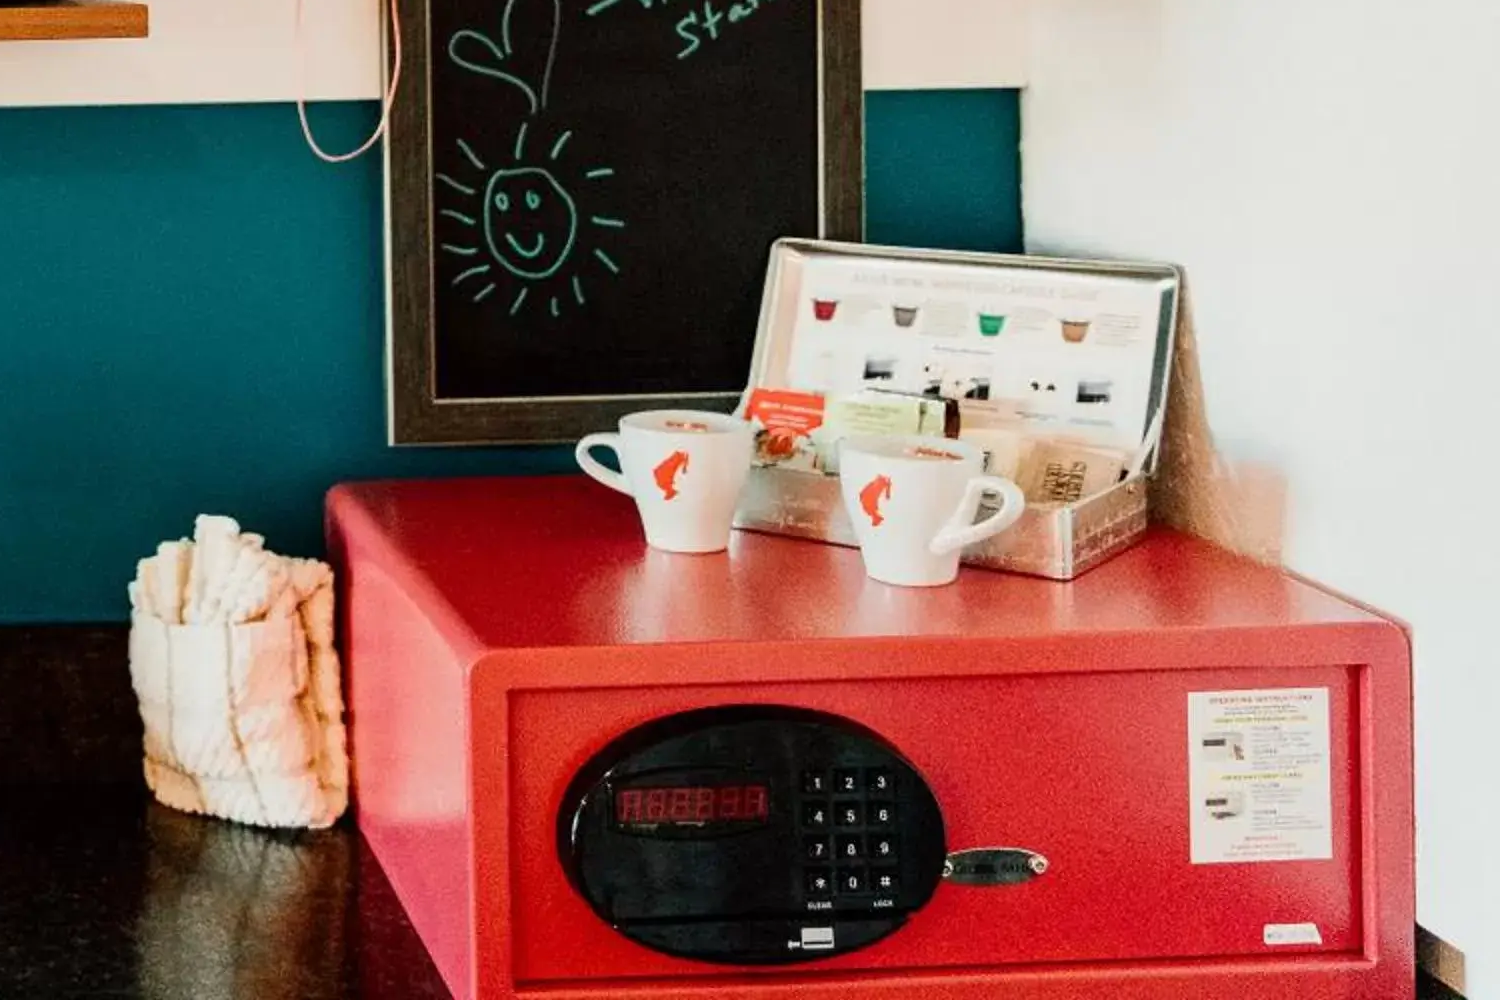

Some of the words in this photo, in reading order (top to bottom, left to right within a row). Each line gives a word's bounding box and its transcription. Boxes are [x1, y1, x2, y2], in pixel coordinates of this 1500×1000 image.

[814, 777, 821, 789] 1
[845, 777, 854, 789] 2
[877, 776, 886, 789] 3
[814, 810, 824, 823] 4
[846, 810, 855, 822] 5
[879, 809, 888, 821] 6
[815, 843, 824, 856] 7
[847, 843, 856, 855] 8
[880, 842, 889, 854] 9
[849, 876, 857, 889] 0
